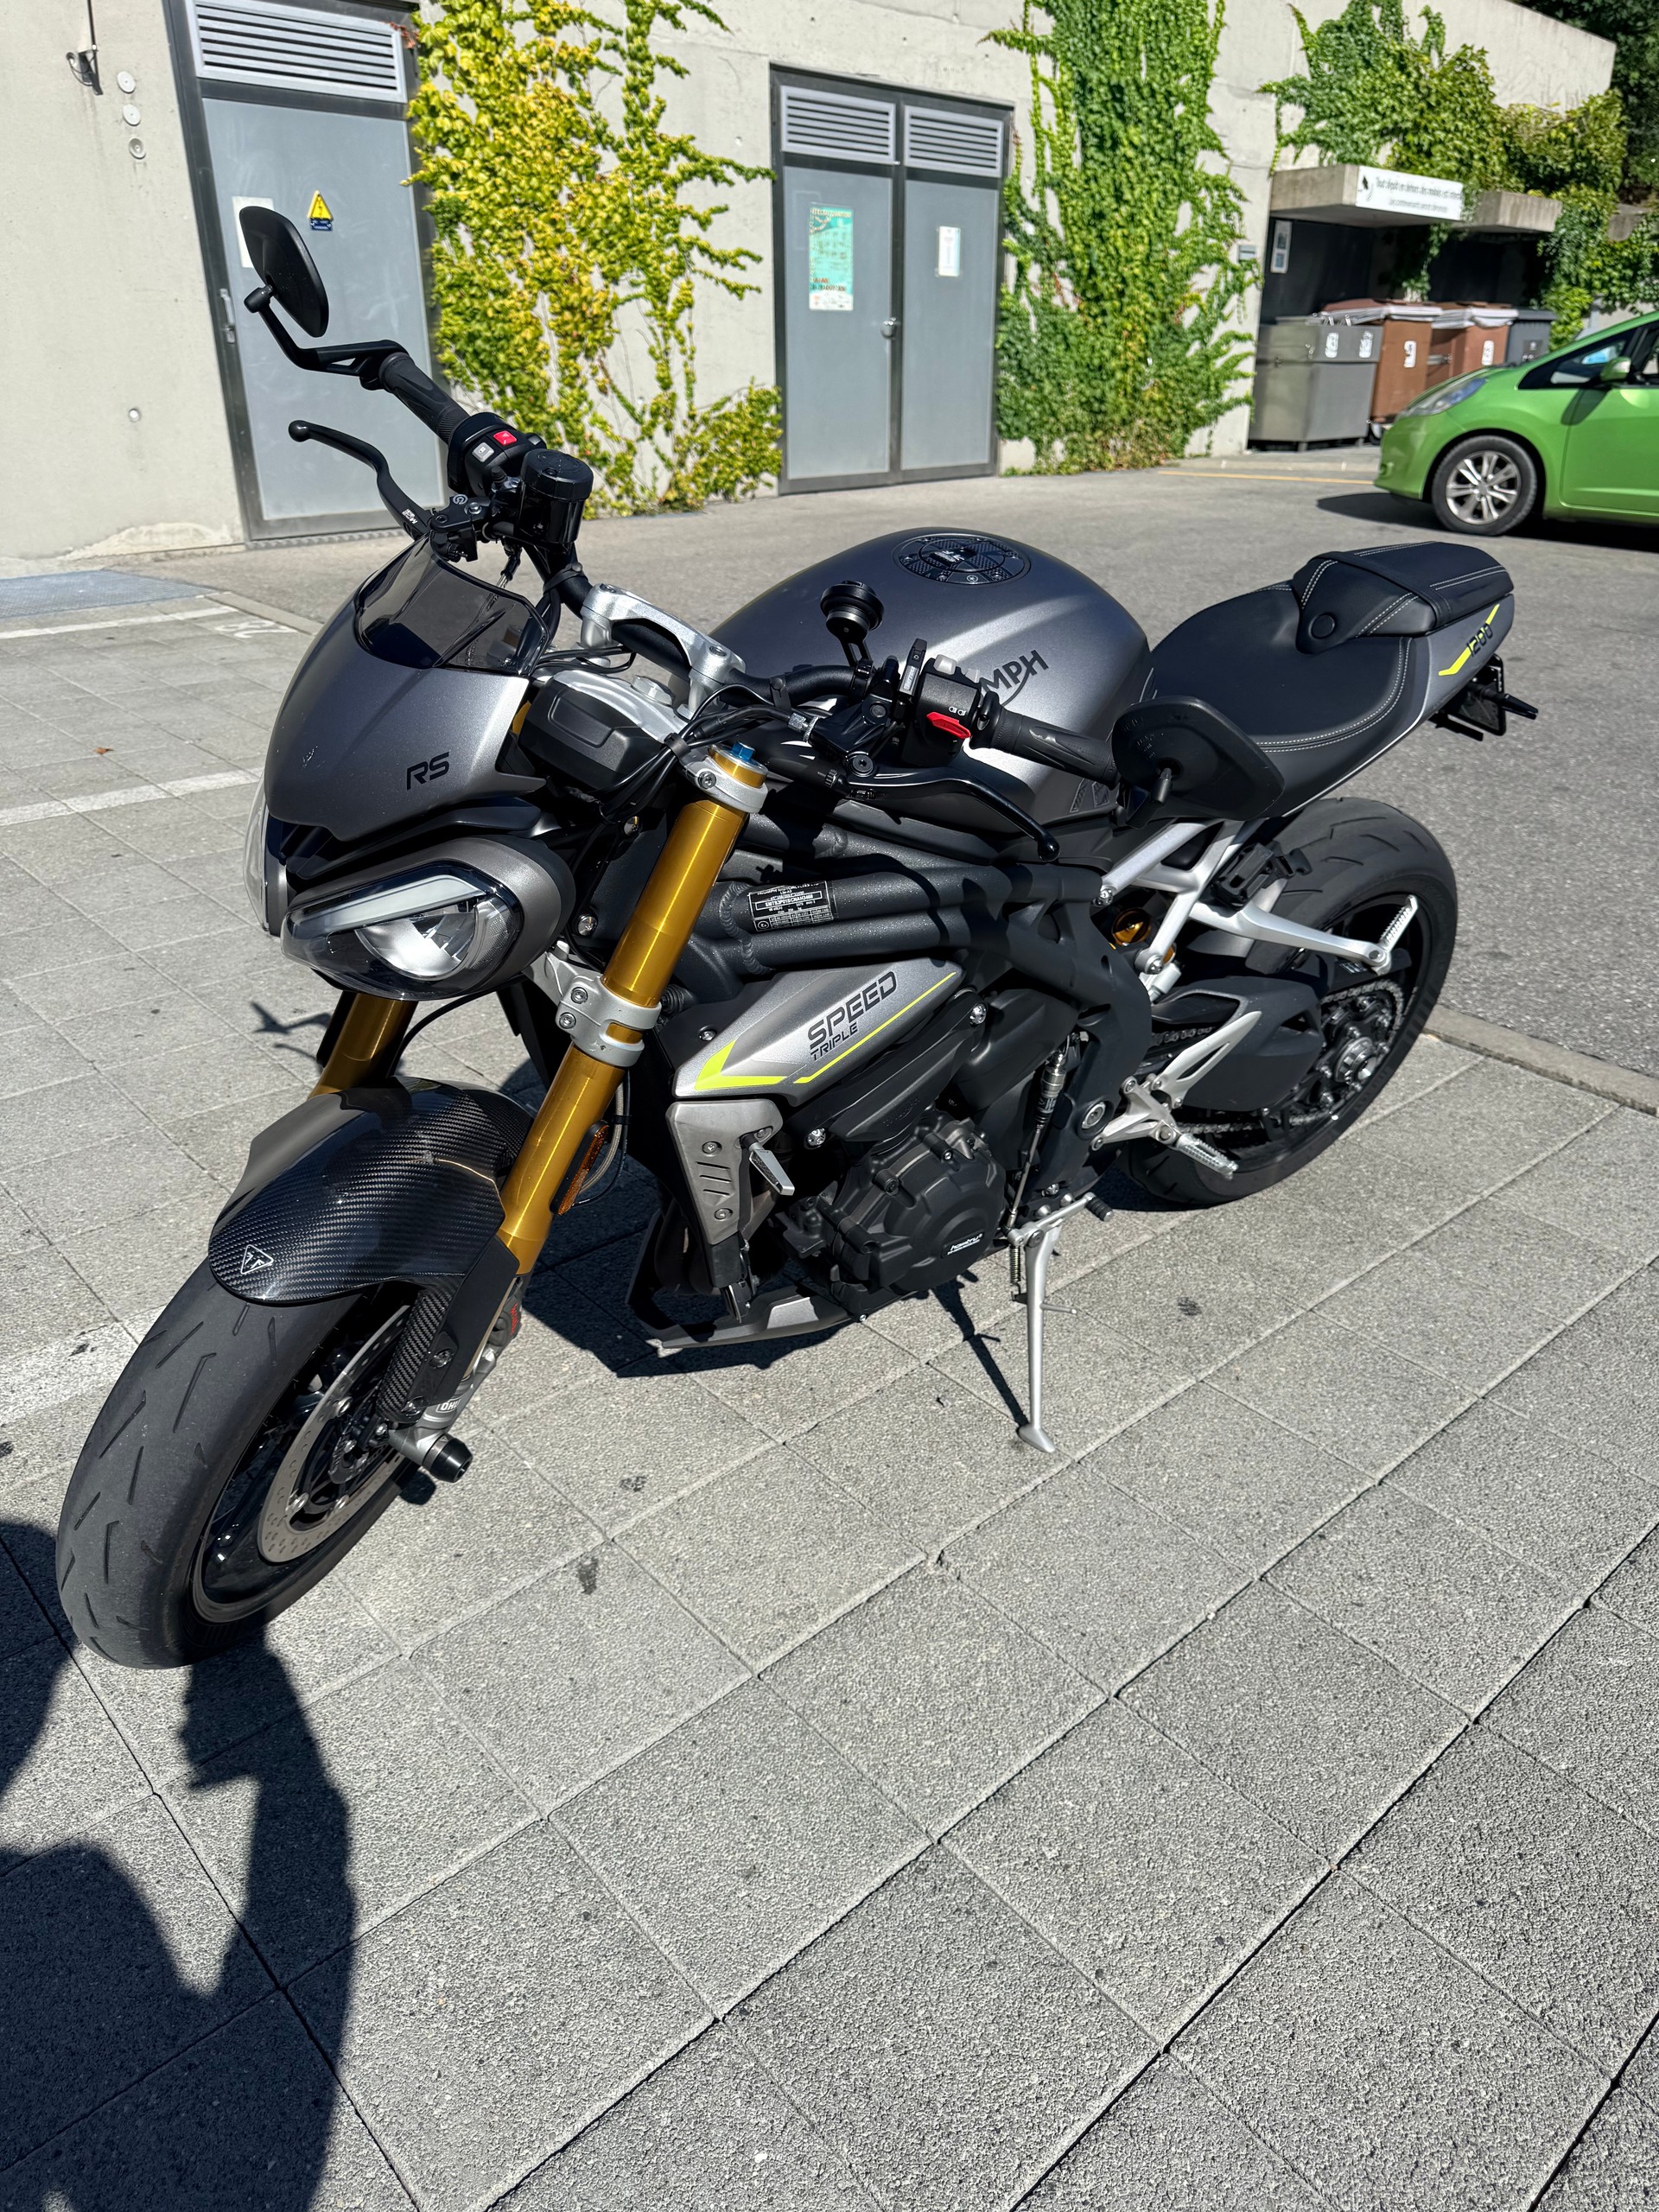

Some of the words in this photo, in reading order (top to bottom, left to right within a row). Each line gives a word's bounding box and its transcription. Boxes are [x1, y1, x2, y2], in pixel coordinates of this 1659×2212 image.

[1465, 623, 1493, 657] 1200
[979, 650, 1049, 692] MPH
[406, 752, 449, 791] RS
[808, 971, 897, 1050] SPEED
[810, 1021, 858, 1061] TRIPLE
